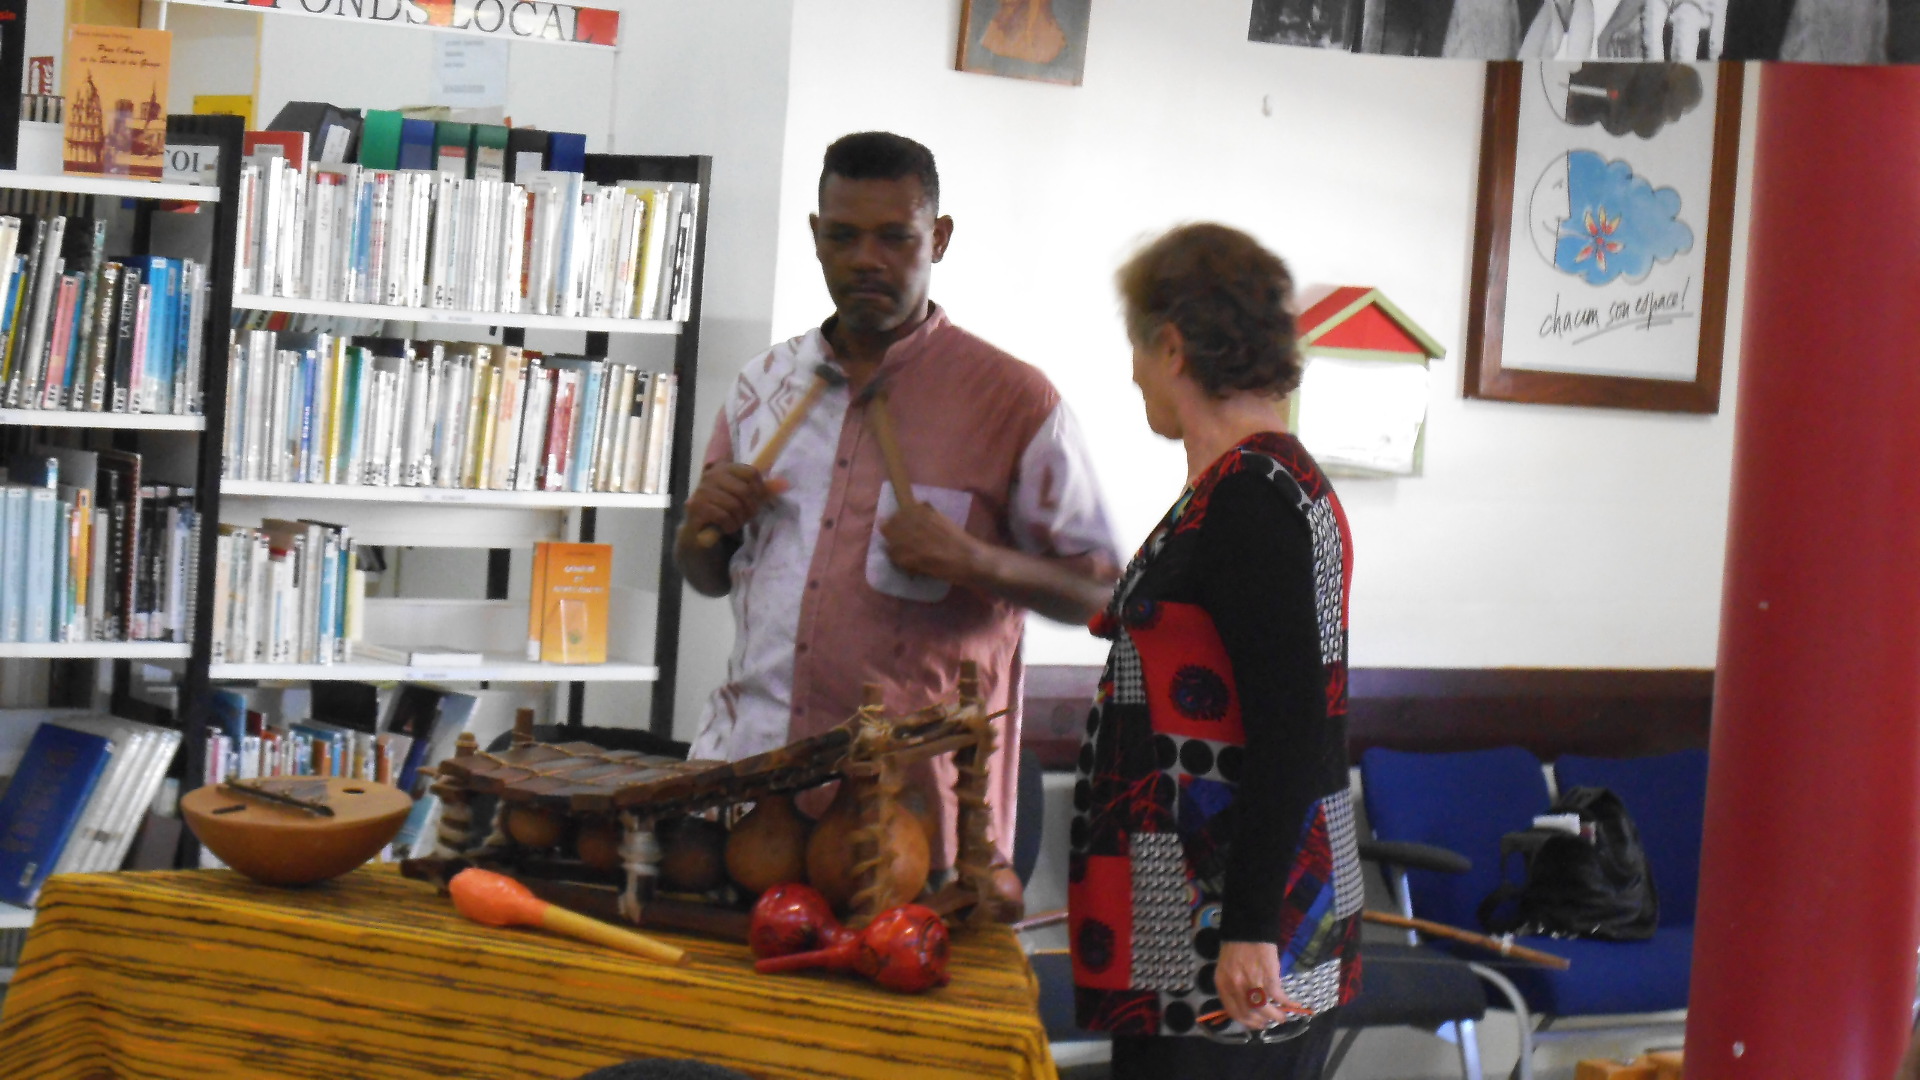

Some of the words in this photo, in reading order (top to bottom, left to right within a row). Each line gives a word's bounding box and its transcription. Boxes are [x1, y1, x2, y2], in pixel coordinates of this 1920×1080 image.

[450, 0, 593, 43] LOCAL
[1539, 293, 1600, 339] chacun
[1607, 300, 1631, 324] son
